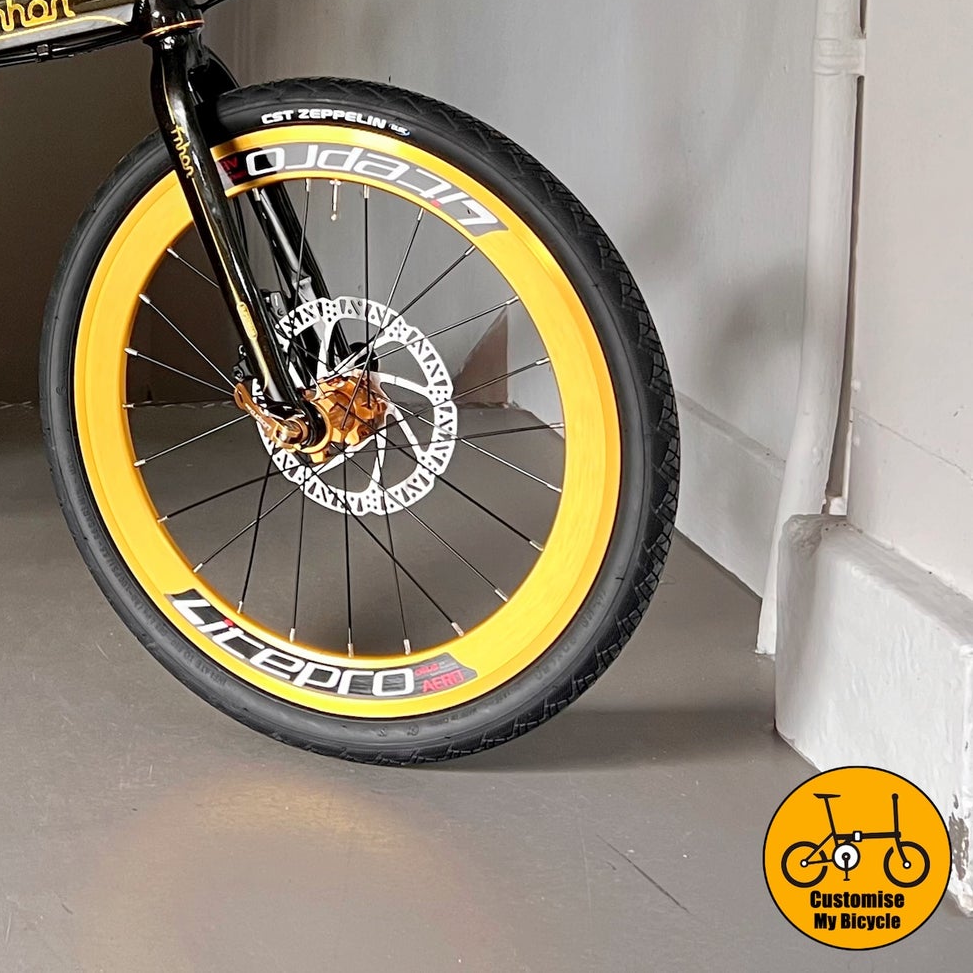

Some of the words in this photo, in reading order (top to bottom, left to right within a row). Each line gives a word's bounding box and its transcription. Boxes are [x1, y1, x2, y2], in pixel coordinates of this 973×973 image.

[261, 109, 294, 125] CST
[297, 108, 387, 130] ZEPPELIN
[422, 669, 464, 692] AERO
